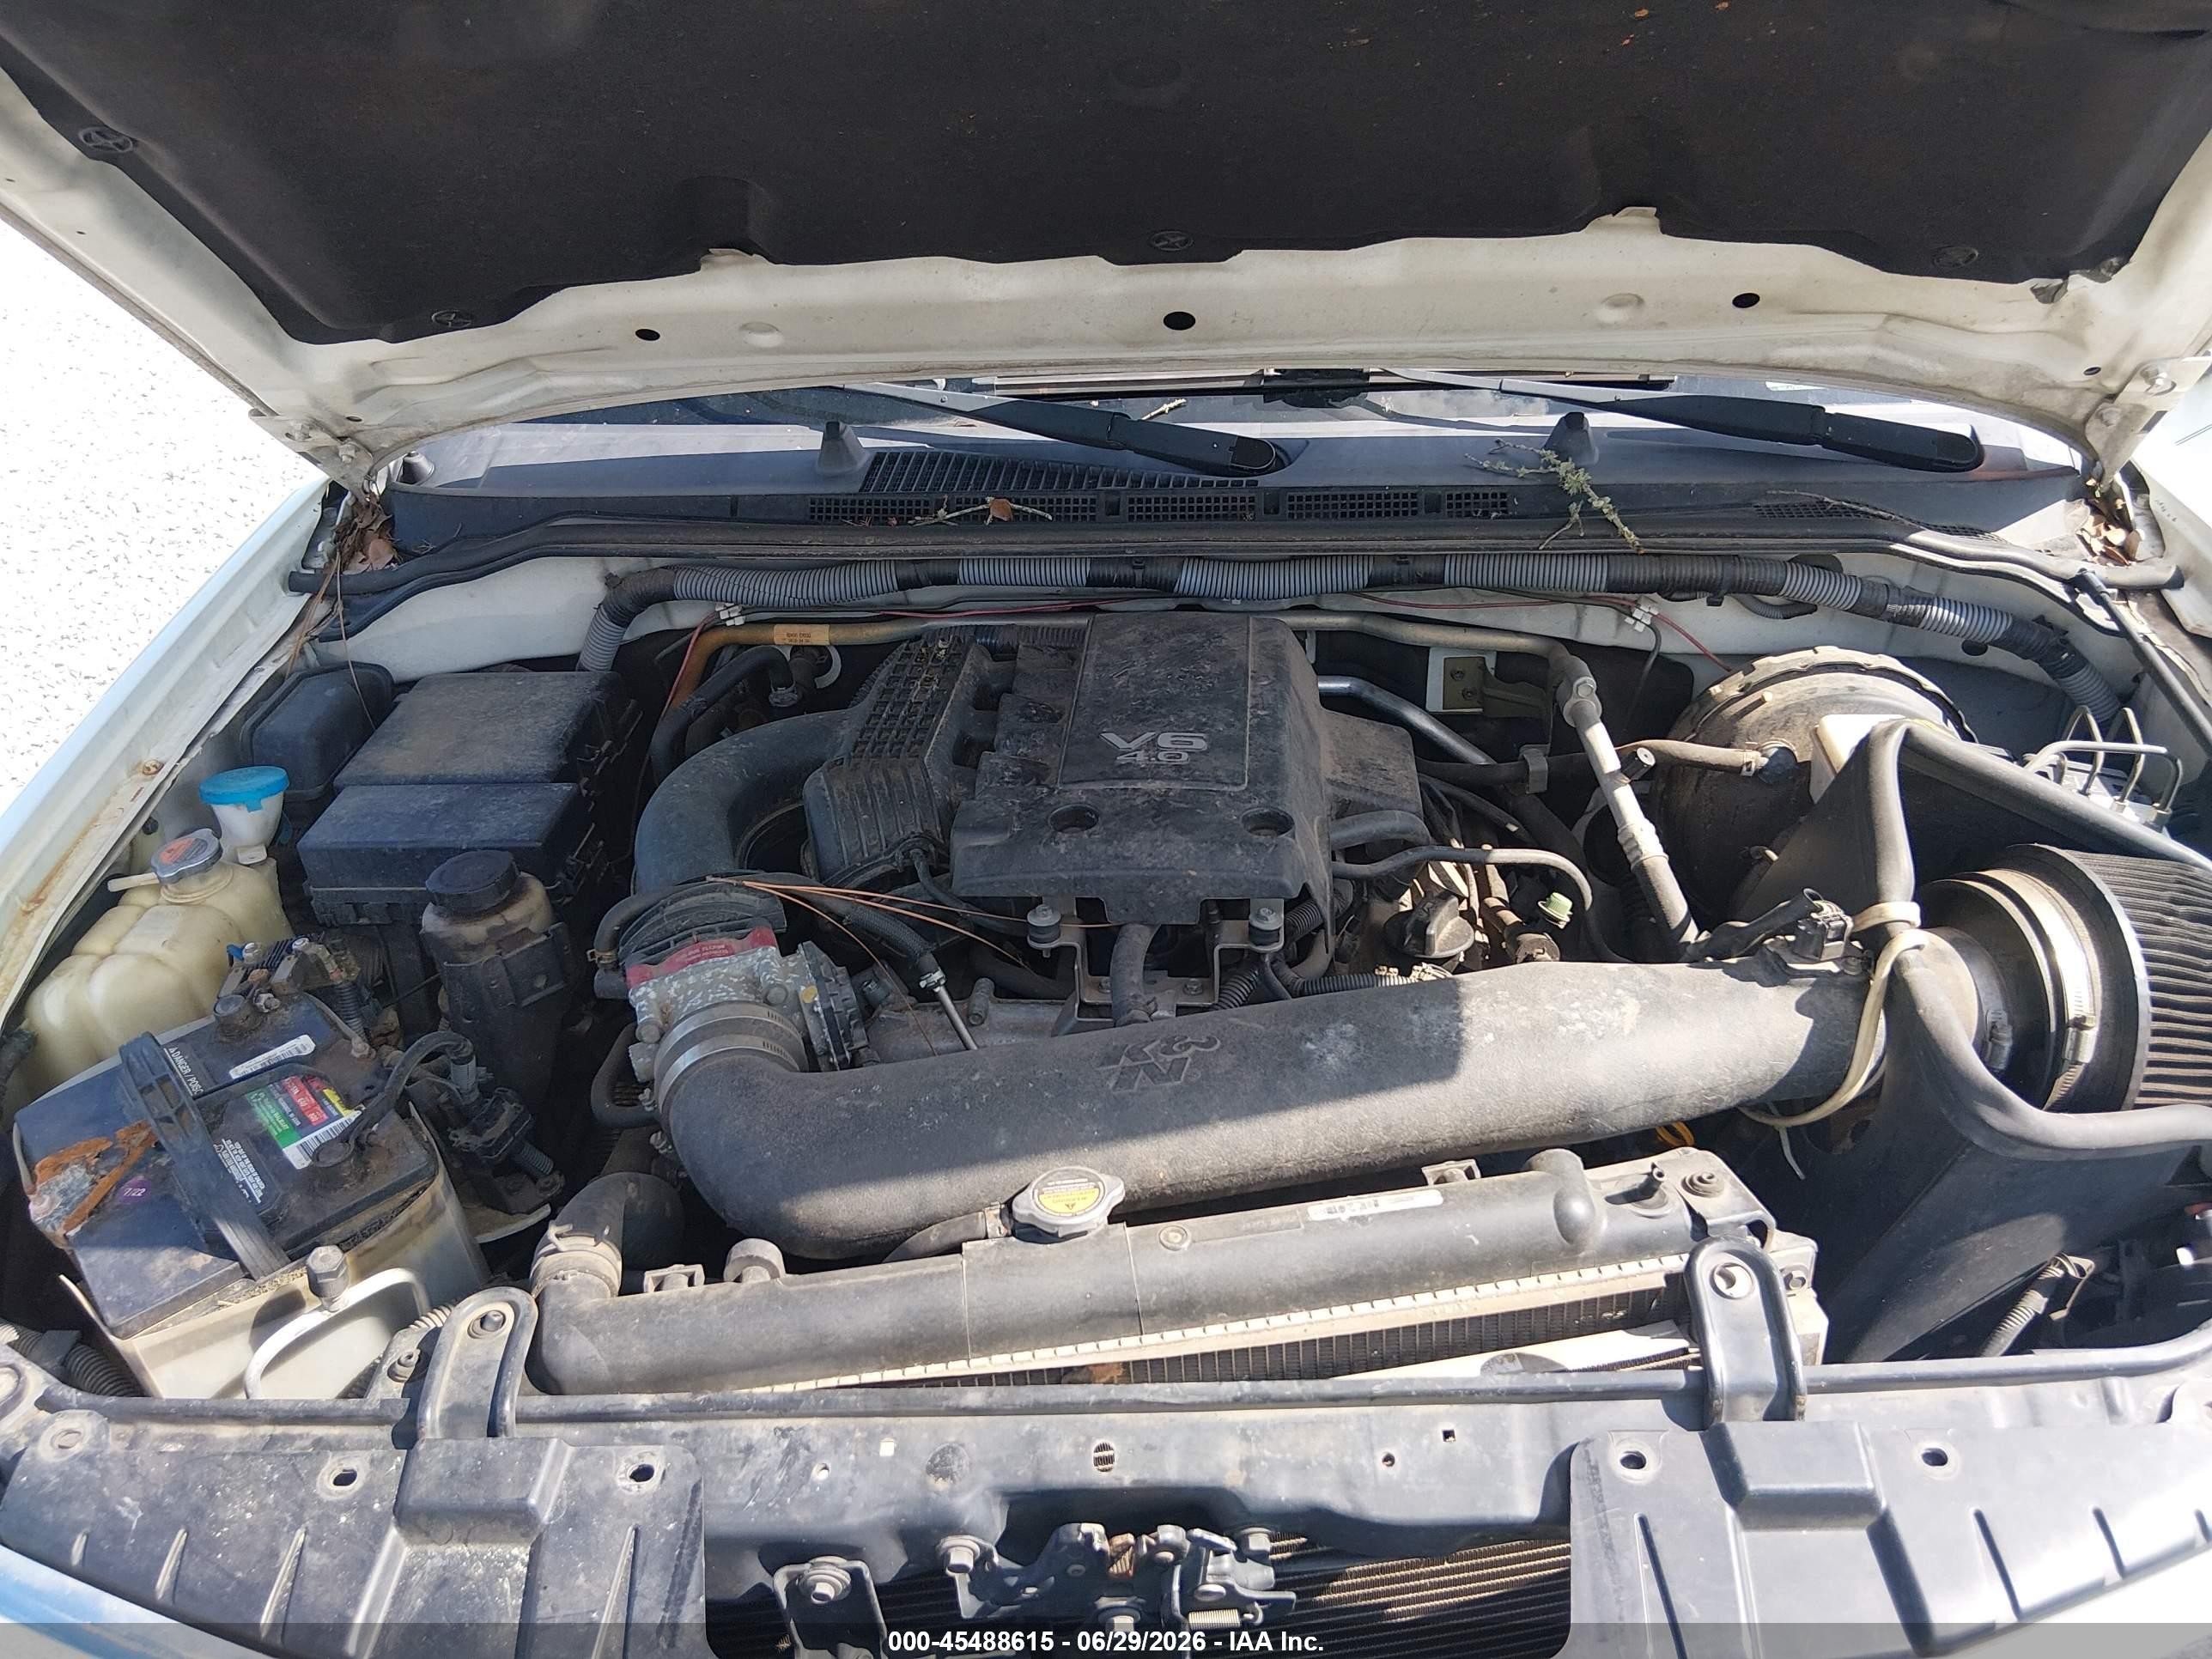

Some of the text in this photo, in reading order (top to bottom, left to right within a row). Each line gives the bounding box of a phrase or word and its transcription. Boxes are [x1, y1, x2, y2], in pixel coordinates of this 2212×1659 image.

[1099, 732, 1207, 752] V6
[1115, 750, 1189, 767] 4.0
[171, 1050, 191, 1075] DANGER
[123, 1188, 146, 1197] 7/22
